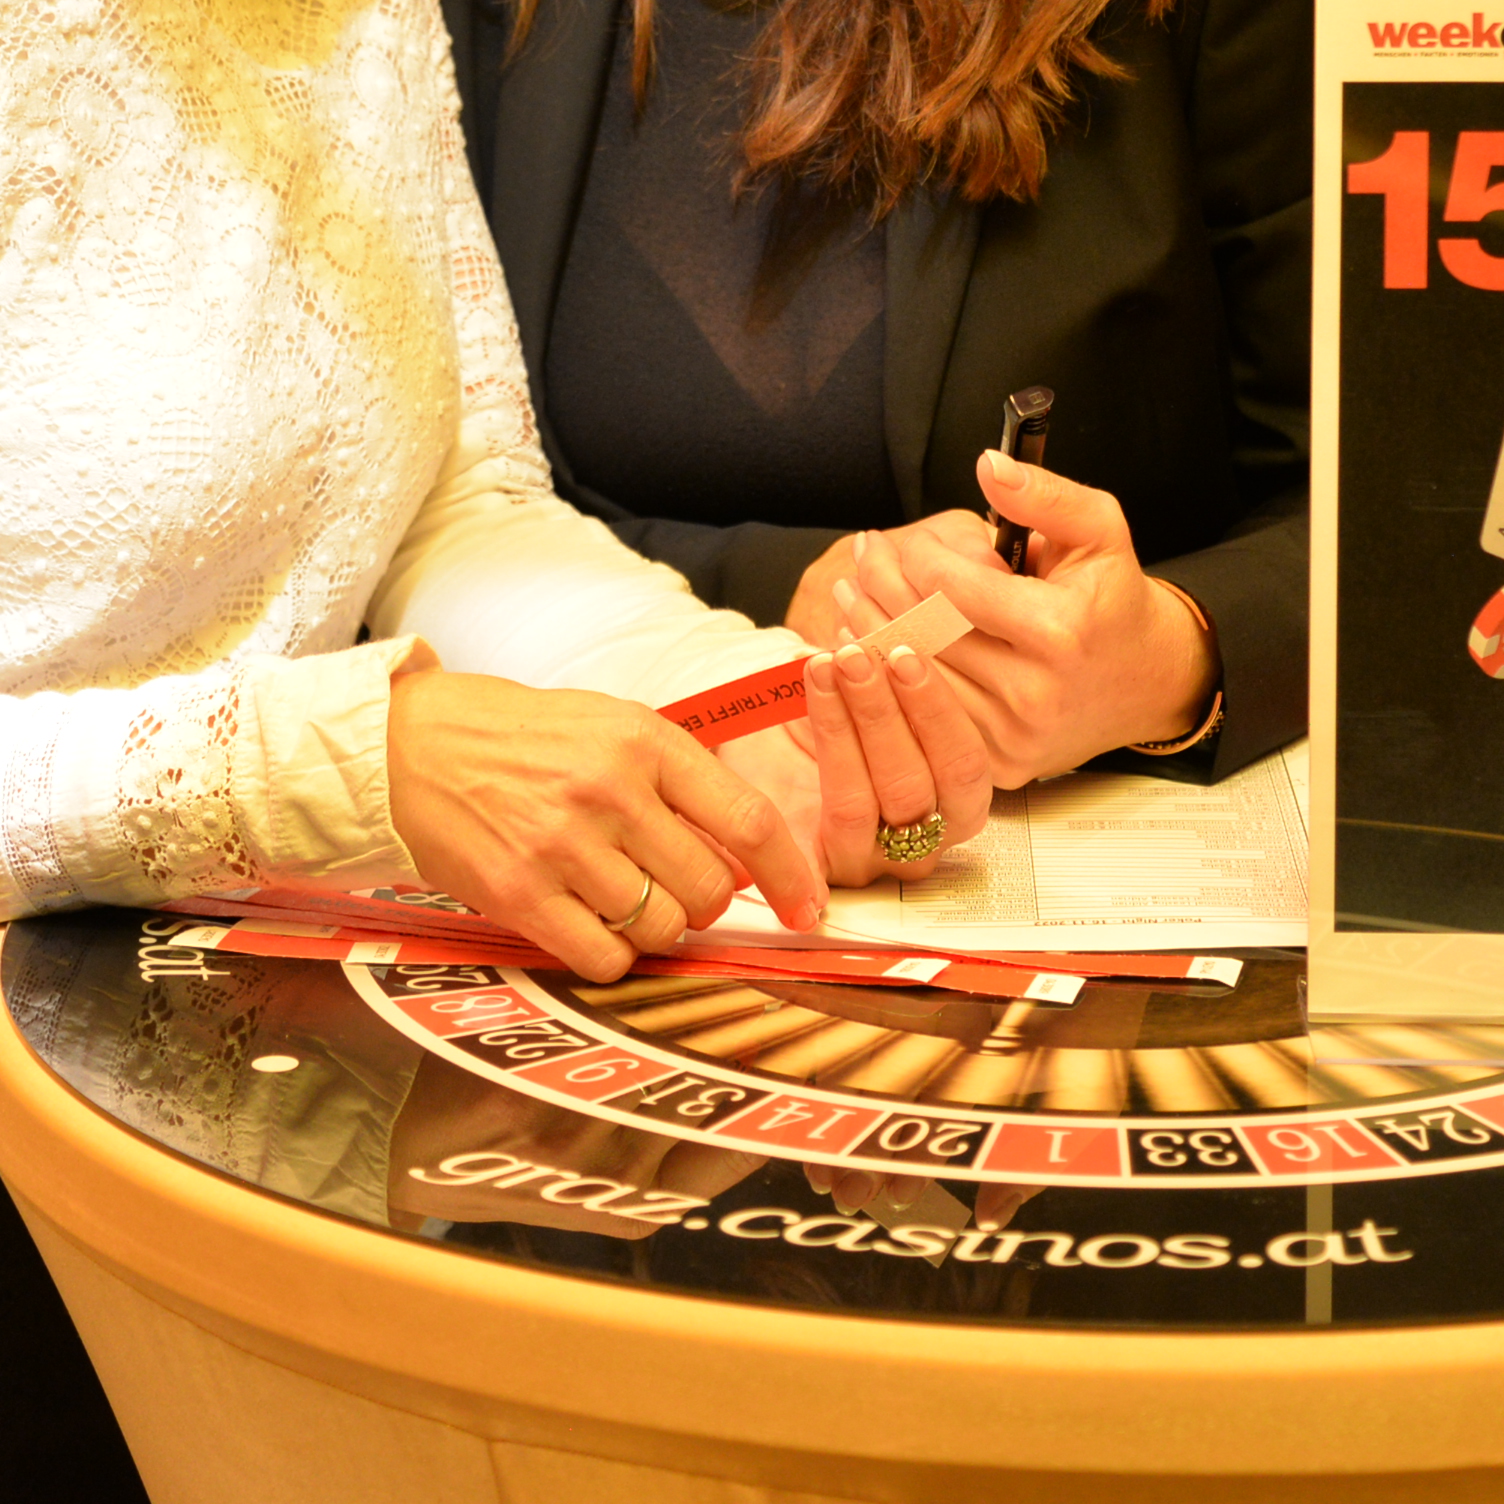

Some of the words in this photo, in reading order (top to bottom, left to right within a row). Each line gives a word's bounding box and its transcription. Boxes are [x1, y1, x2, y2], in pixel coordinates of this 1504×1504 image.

[707, 692, 770, 725] TRIFFT
[771, 677, 805, 704] ÜCK
[430, 994, 531, 1028] 18
[478, 1022, 589, 1061] 22
[639, 1076, 747, 1117] 31
[757, 1100, 858, 1141] 14
[877, 1117, 984, 1158] 20
[1374, 1106, 1493, 1152] 24
[1044, 1129, 1072, 1164] 1
[1139, 1128, 1240, 1167] 33
[1272, 1121, 1371, 1164] 16
[408, 1148, 1414, 1270] graz.casinos.at
